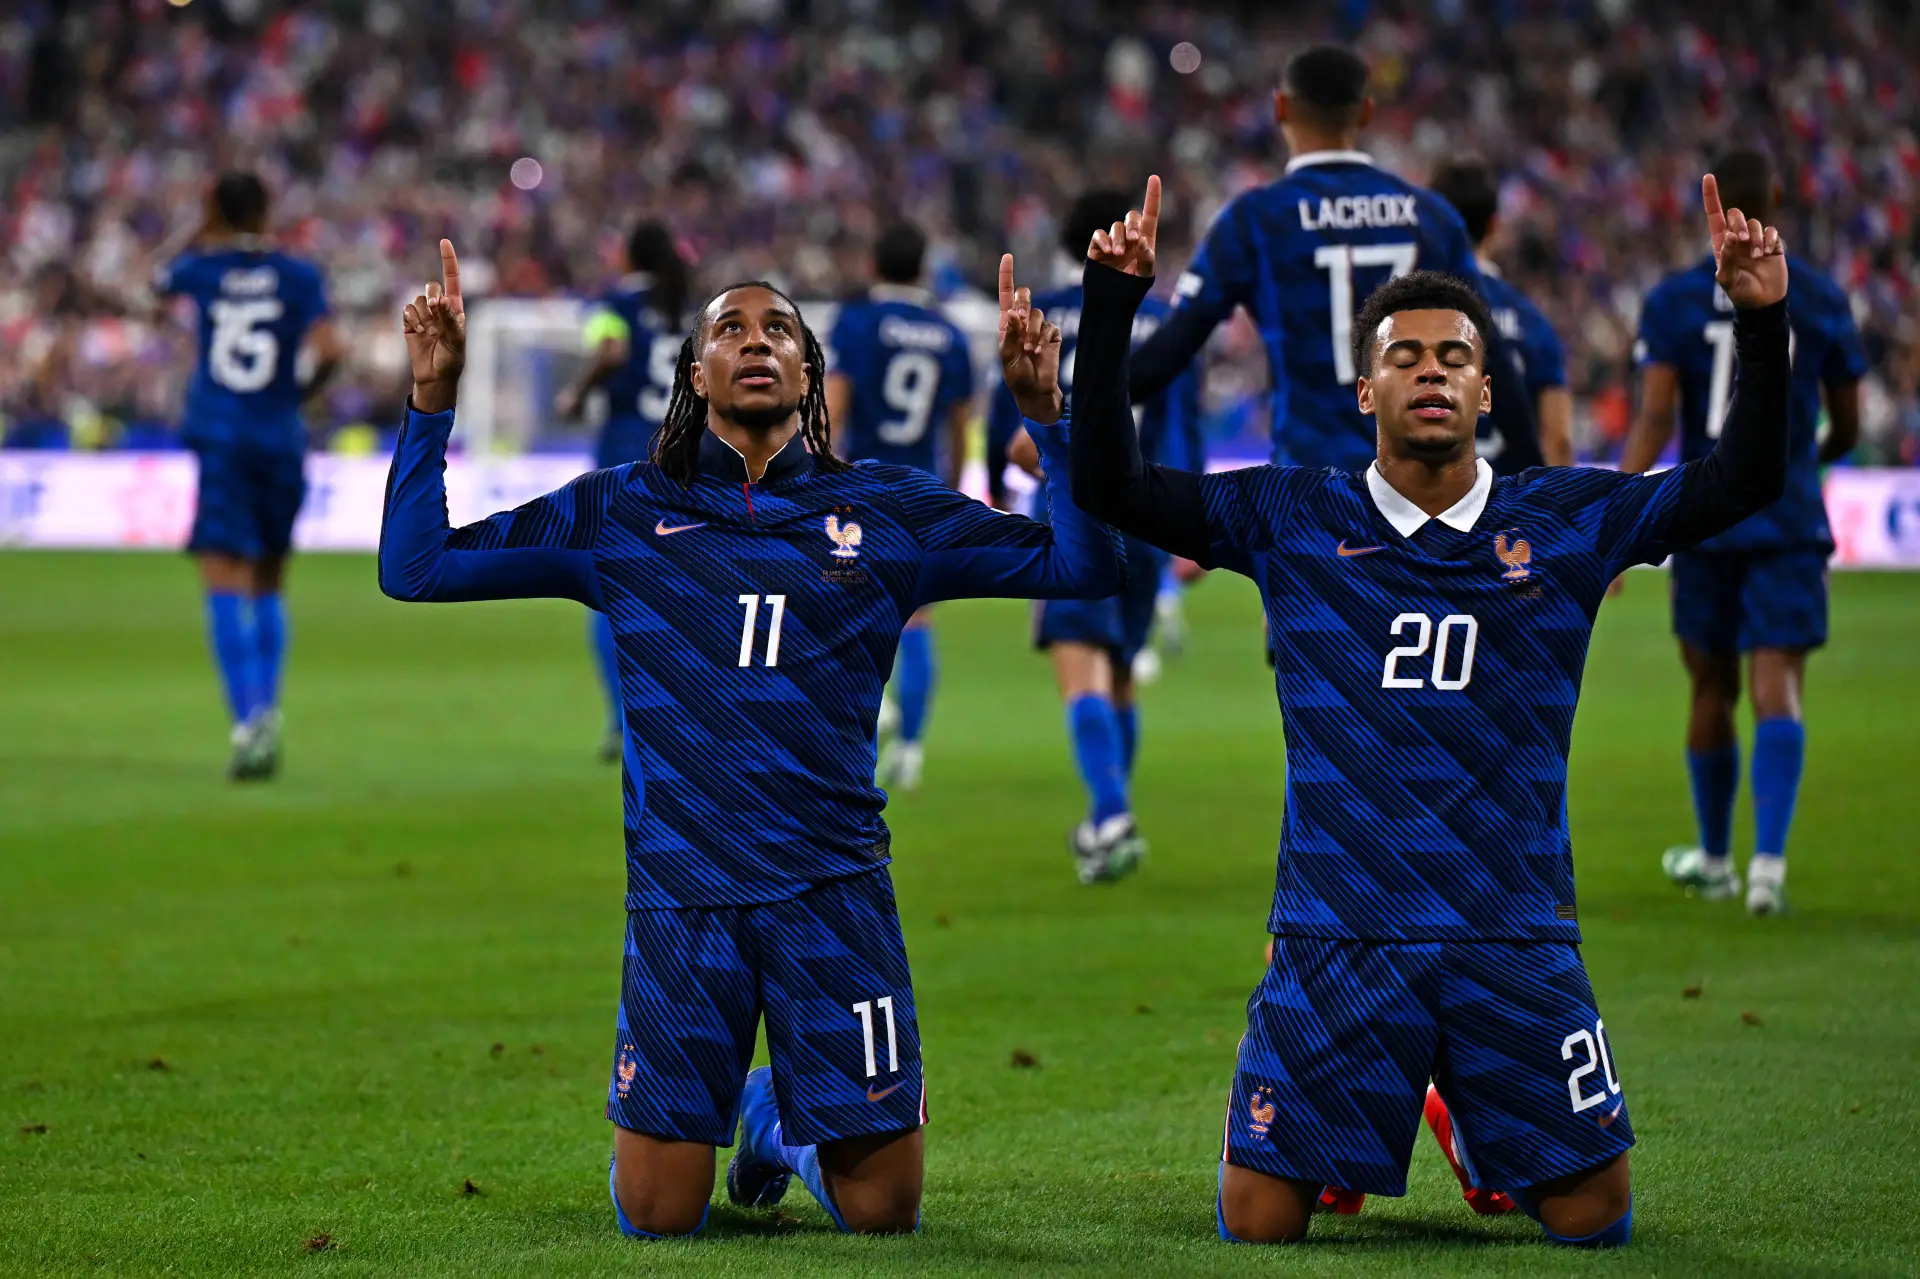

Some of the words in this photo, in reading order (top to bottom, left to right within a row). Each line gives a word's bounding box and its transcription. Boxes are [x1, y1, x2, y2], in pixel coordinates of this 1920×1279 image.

[1299, 194, 1419, 231] LACROIX
[877, 351, 941, 445] 9
[738, 594, 786, 667] 11
[1381, 612, 1479, 690] 20
[852, 995, 899, 1077] 11
[1561, 1018, 1620, 1113] 20
